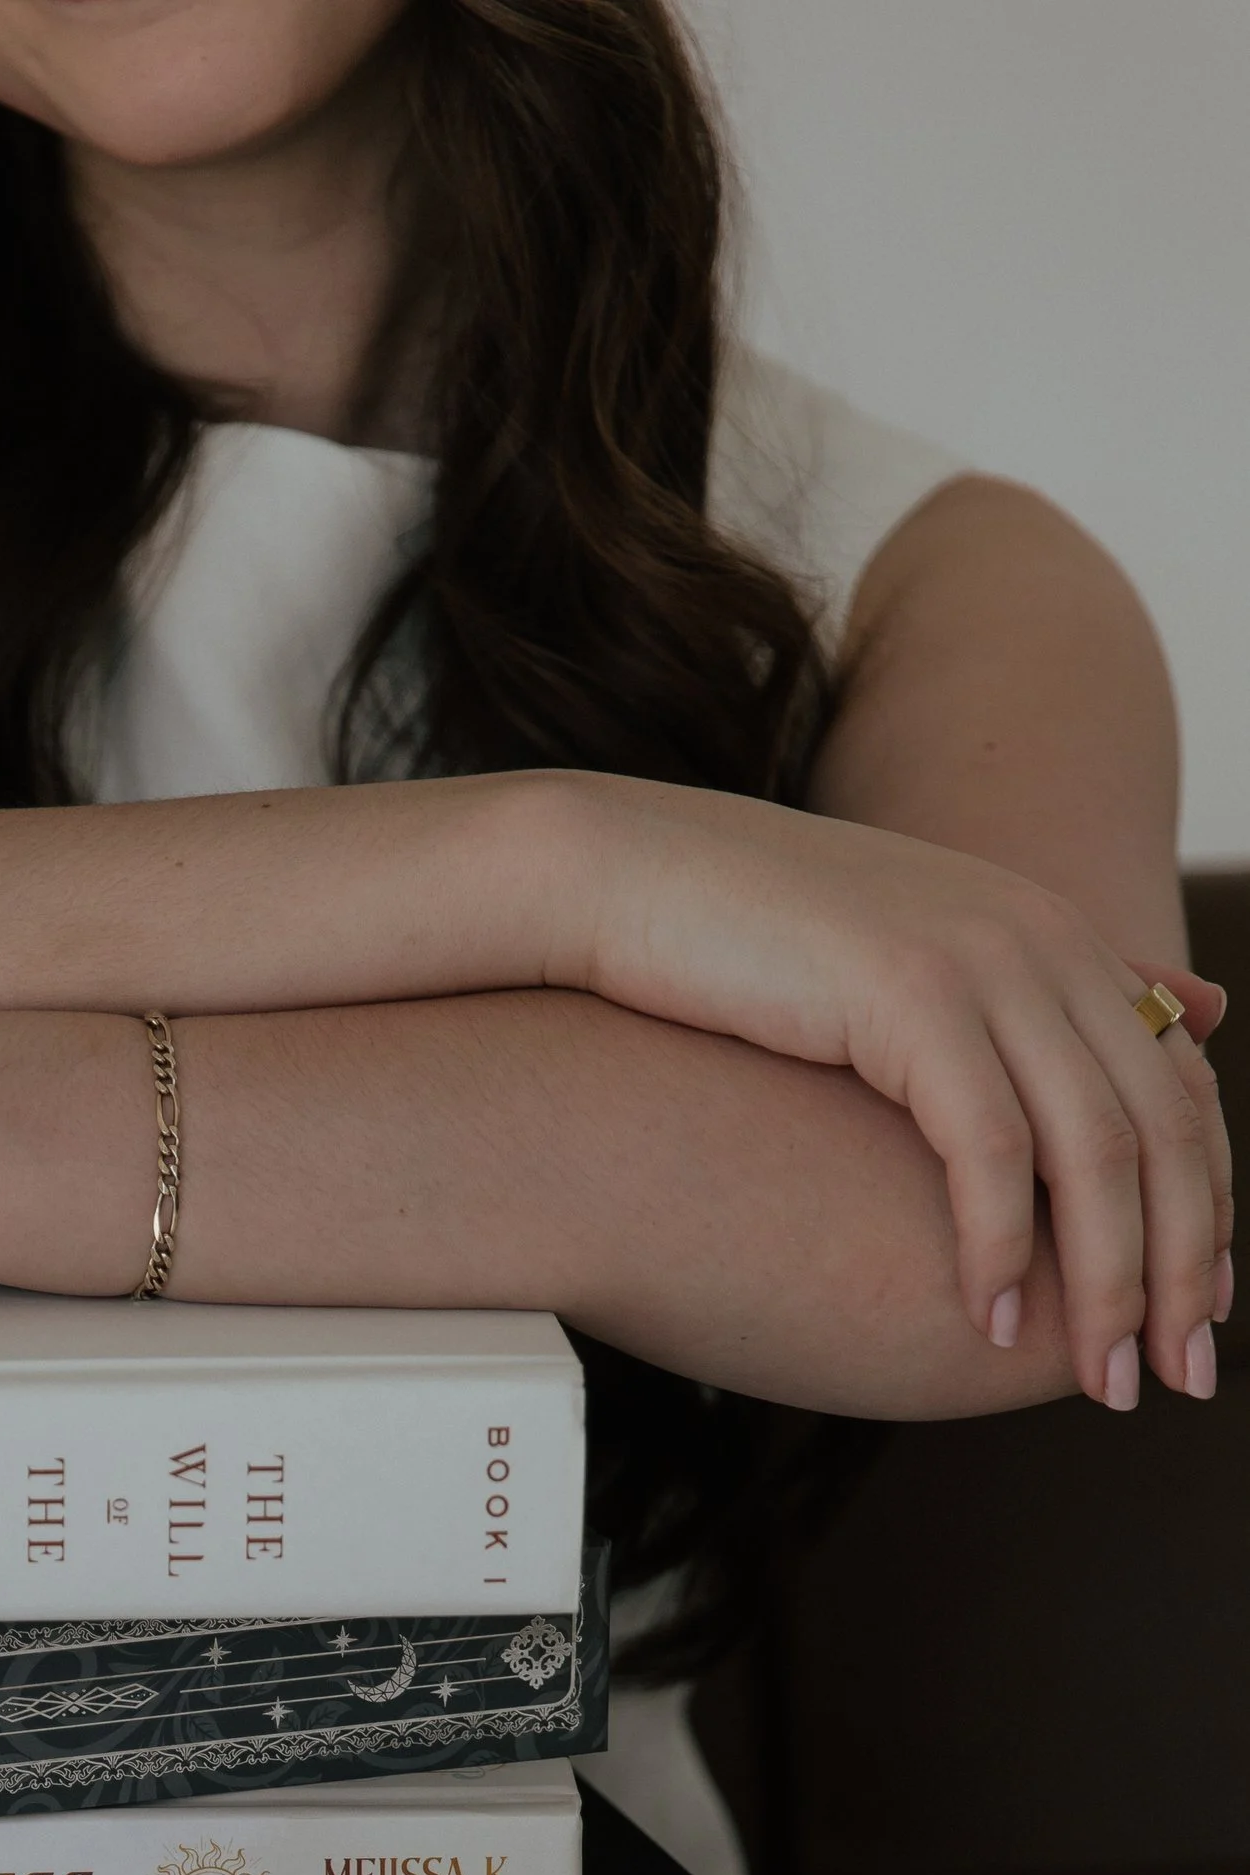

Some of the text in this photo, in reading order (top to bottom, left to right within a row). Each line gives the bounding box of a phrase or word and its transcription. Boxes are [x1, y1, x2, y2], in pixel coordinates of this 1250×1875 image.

[27, 1457, 66, 1564] THE
[111, 1497, 130, 1526] OF
[167, 1442, 207, 1578] WILL
[245, 1454, 285, 1561] THE
[484, 1425, 511, 1551] BOOK
